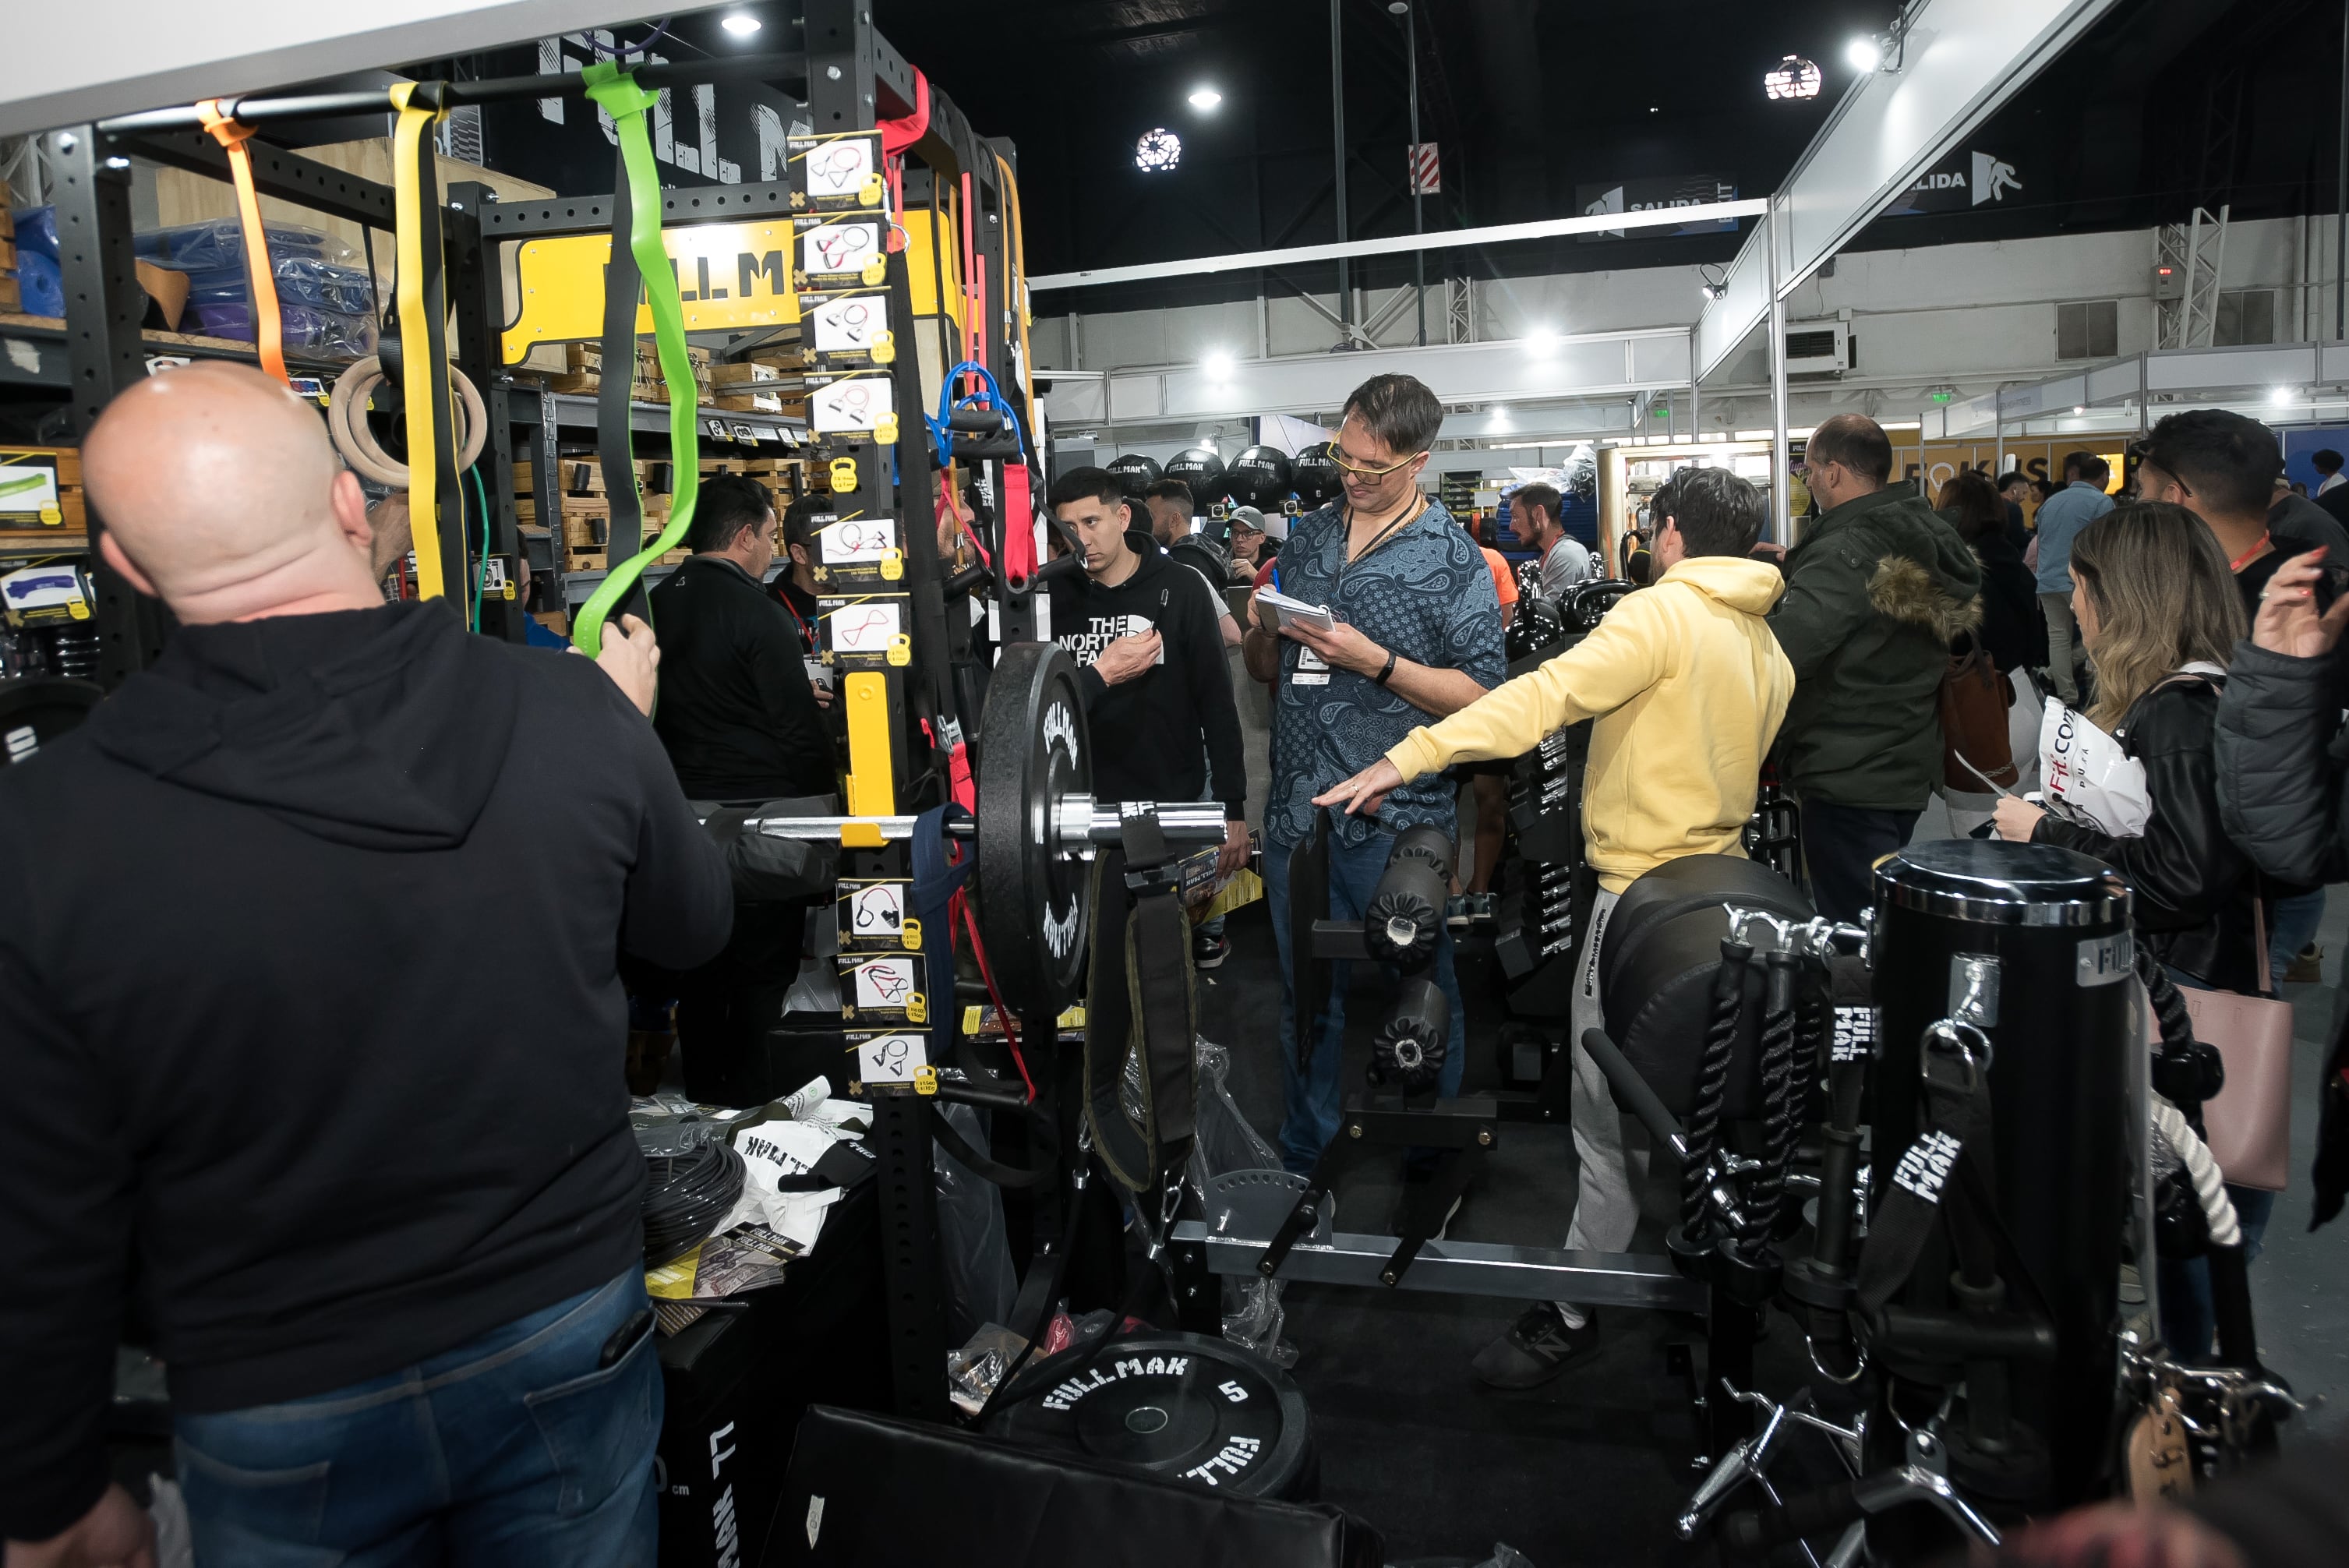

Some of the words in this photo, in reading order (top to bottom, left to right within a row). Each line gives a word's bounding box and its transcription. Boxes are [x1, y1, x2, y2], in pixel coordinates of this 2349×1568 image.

[1911, 172, 1966, 191] LIDA
[1238, 458, 1256, 468] FULL
[1089, 615, 1127, 634] THE
[1060, 633, 1117, 652] NORT
[1076, 650, 1104, 668] FA
[1832, 1008, 1853, 1061] MAK
[1849, 1008, 1870, 1060] FULL
[1894, 1130, 1943, 1191] FULL
[1916, 1134, 1962, 1203] MAK
[1218, 1380, 1249, 1403] 5
[672, 1484, 690, 1496] cm
